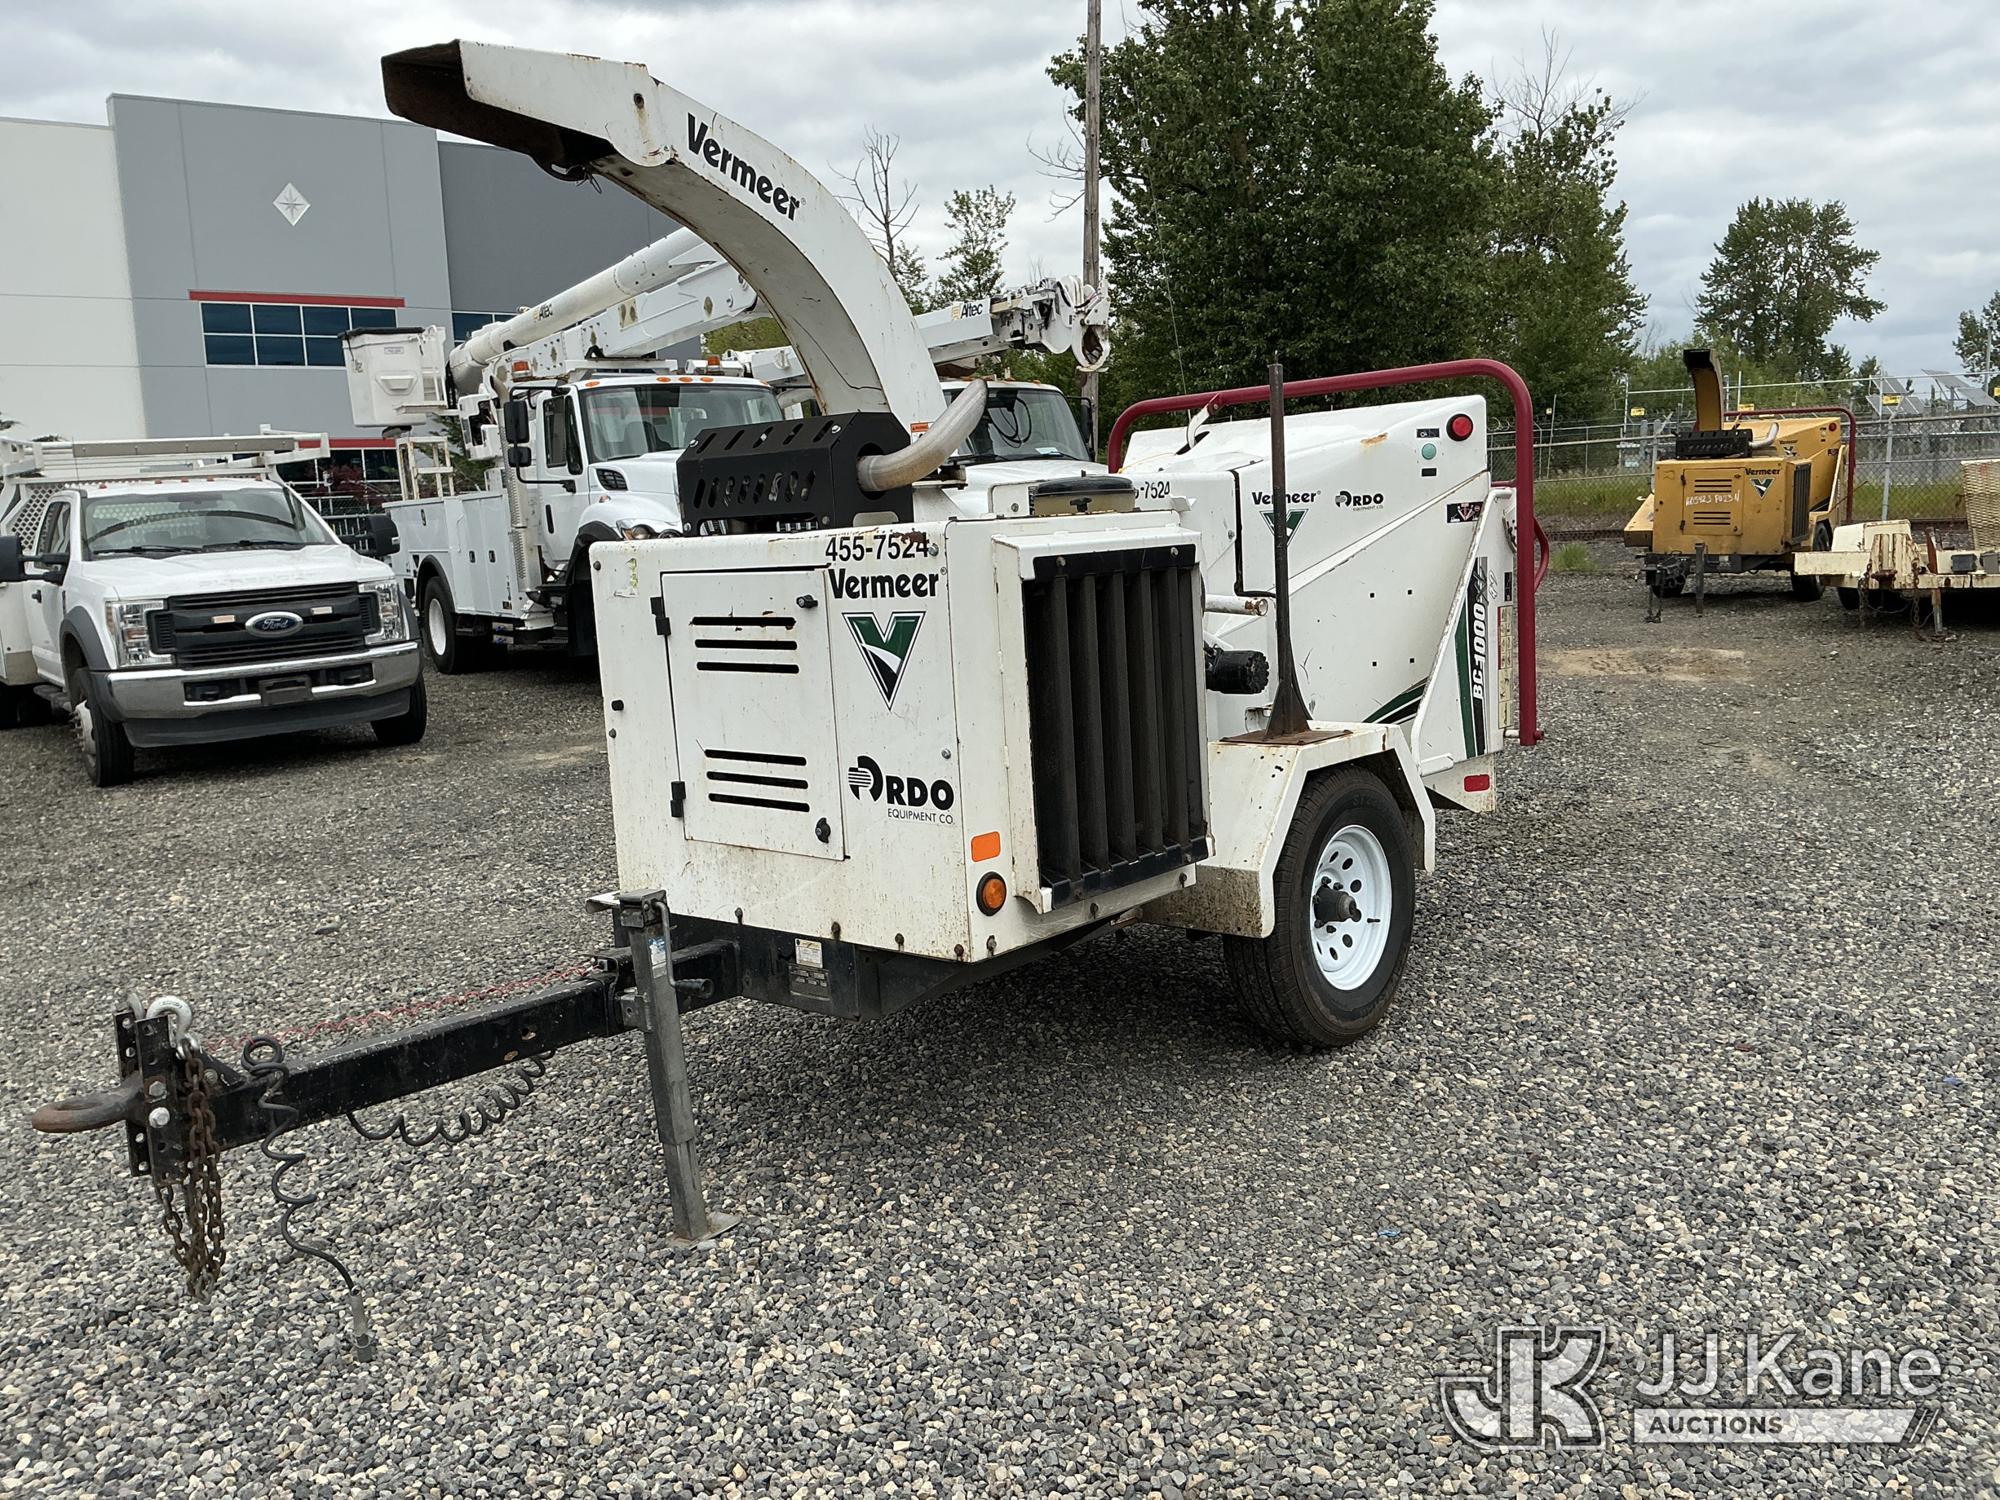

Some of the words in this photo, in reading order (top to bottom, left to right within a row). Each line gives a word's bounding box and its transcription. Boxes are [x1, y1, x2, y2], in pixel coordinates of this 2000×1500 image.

[687, 112, 800, 221] Vermeer
[961, 302, 983, 319] Altec
[825, 532, 929, 561] 455-7524
[828, 568, 939, 599] Vermeer
[262, 617, 289, 631] Ford
[887, 808, 937, 823] EQUIPMENT
